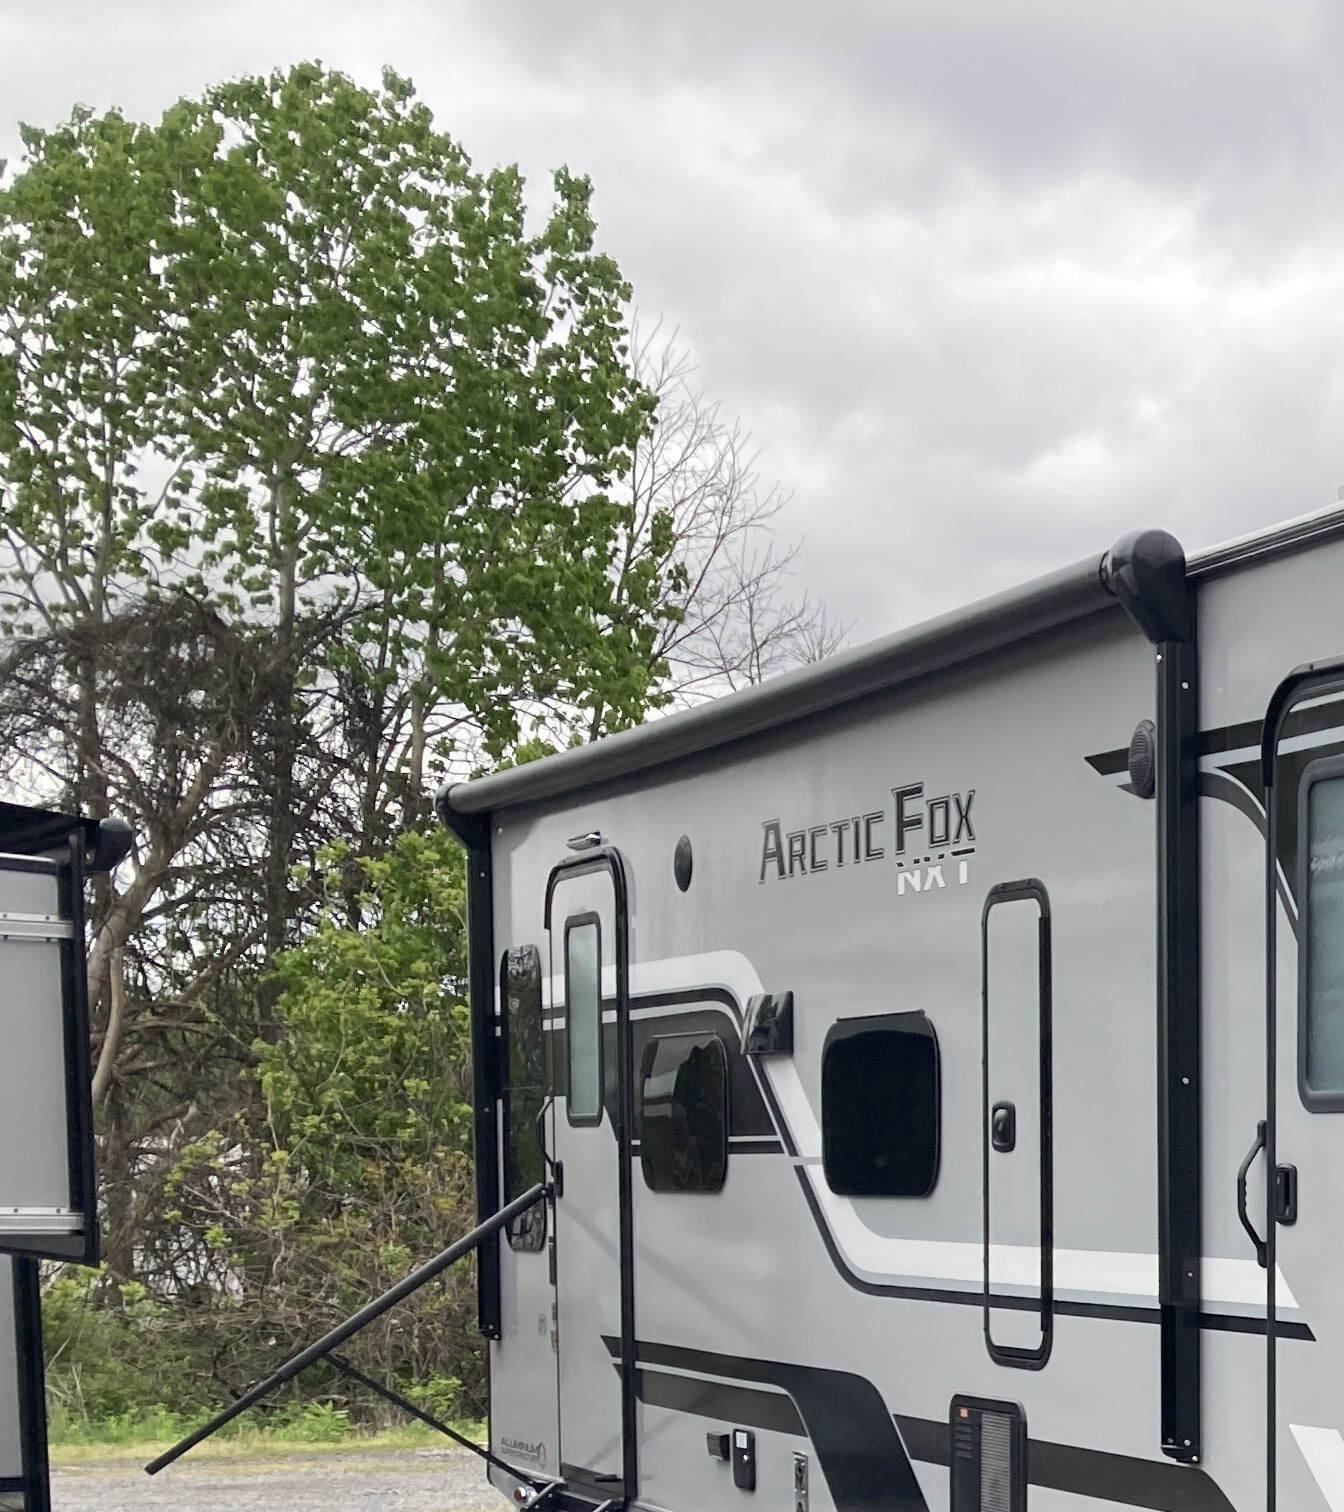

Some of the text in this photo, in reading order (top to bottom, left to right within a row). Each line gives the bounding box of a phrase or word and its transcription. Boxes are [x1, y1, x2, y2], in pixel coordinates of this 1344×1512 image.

[758, 781, 976, 884] ARCTIC FOX
[896, 847, 976, 895] NXT
